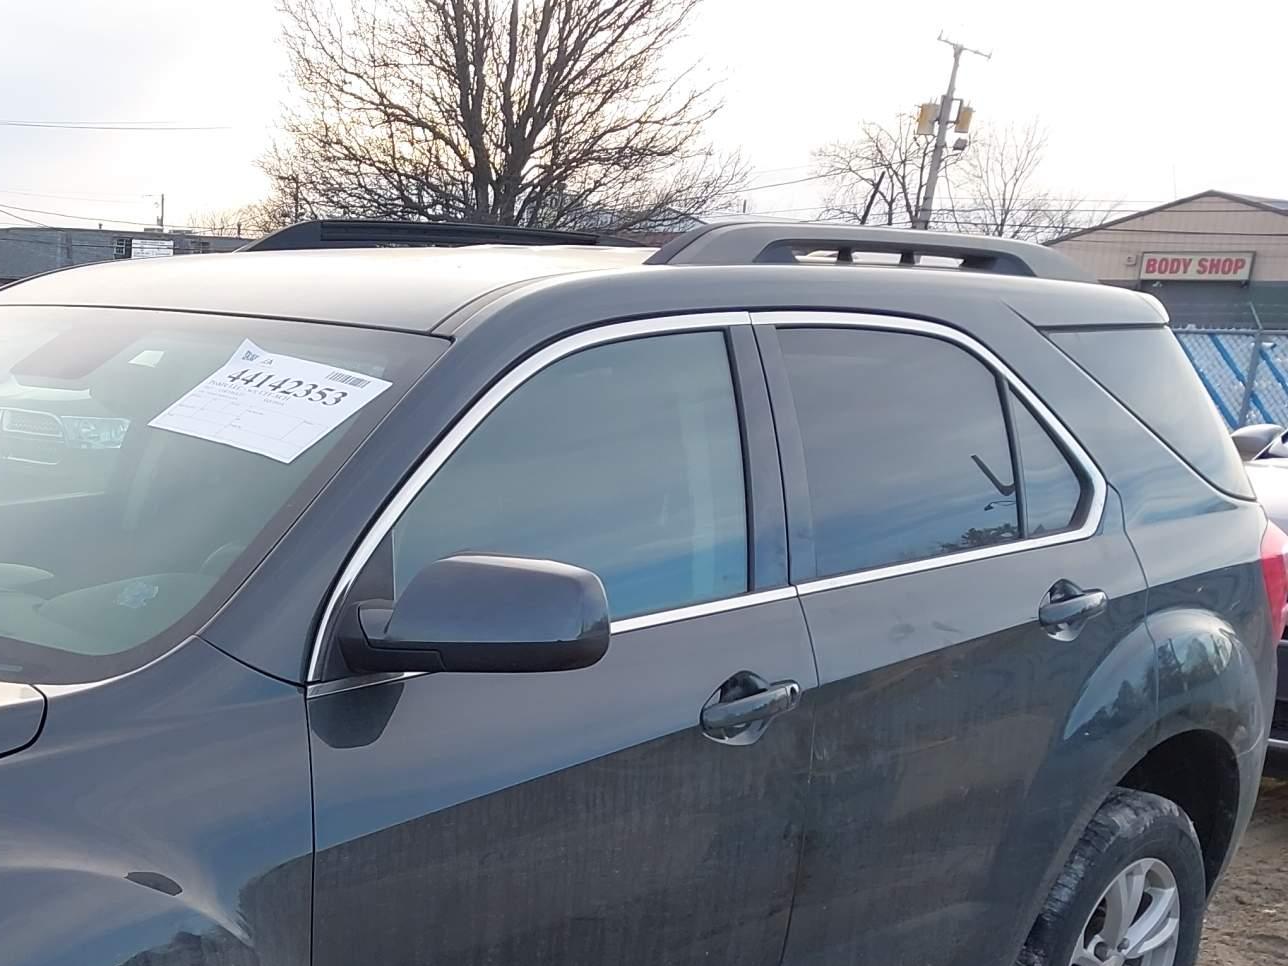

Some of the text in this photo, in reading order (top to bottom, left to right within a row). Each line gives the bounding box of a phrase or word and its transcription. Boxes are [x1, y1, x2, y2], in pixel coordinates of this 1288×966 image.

[1145, 257, 1246, 275] BODY SHOP
[227, 368, 348, 406] 44142353
